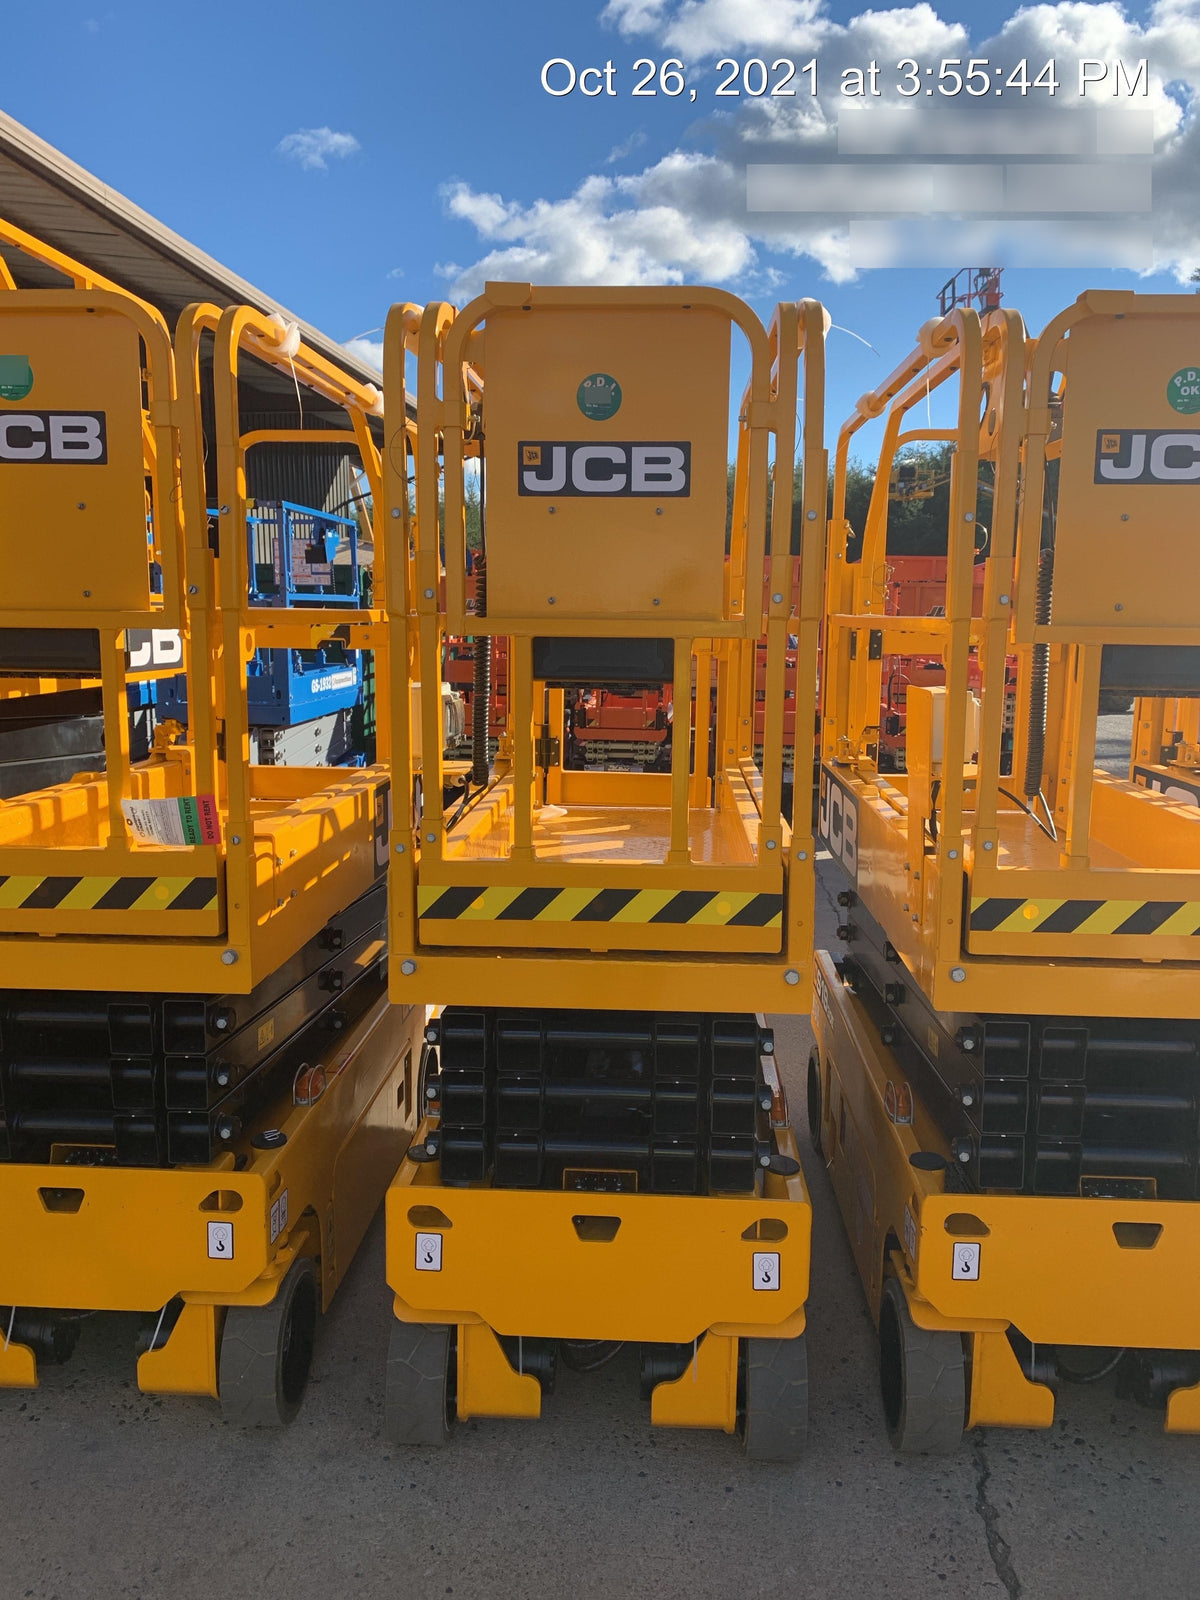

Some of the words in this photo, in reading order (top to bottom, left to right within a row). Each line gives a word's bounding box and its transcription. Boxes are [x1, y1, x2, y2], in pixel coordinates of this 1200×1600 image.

[1180, 385, 1200, 396] OK
[523, 446, 686, 492] JCB
[183, 798, 192, 814] RENT
[203, 800, 211, 815] RENT
[205, 815, 213, 830] NOT
[820, 776, 857, 878] JCB
[207, 830, 214, 840] DO
